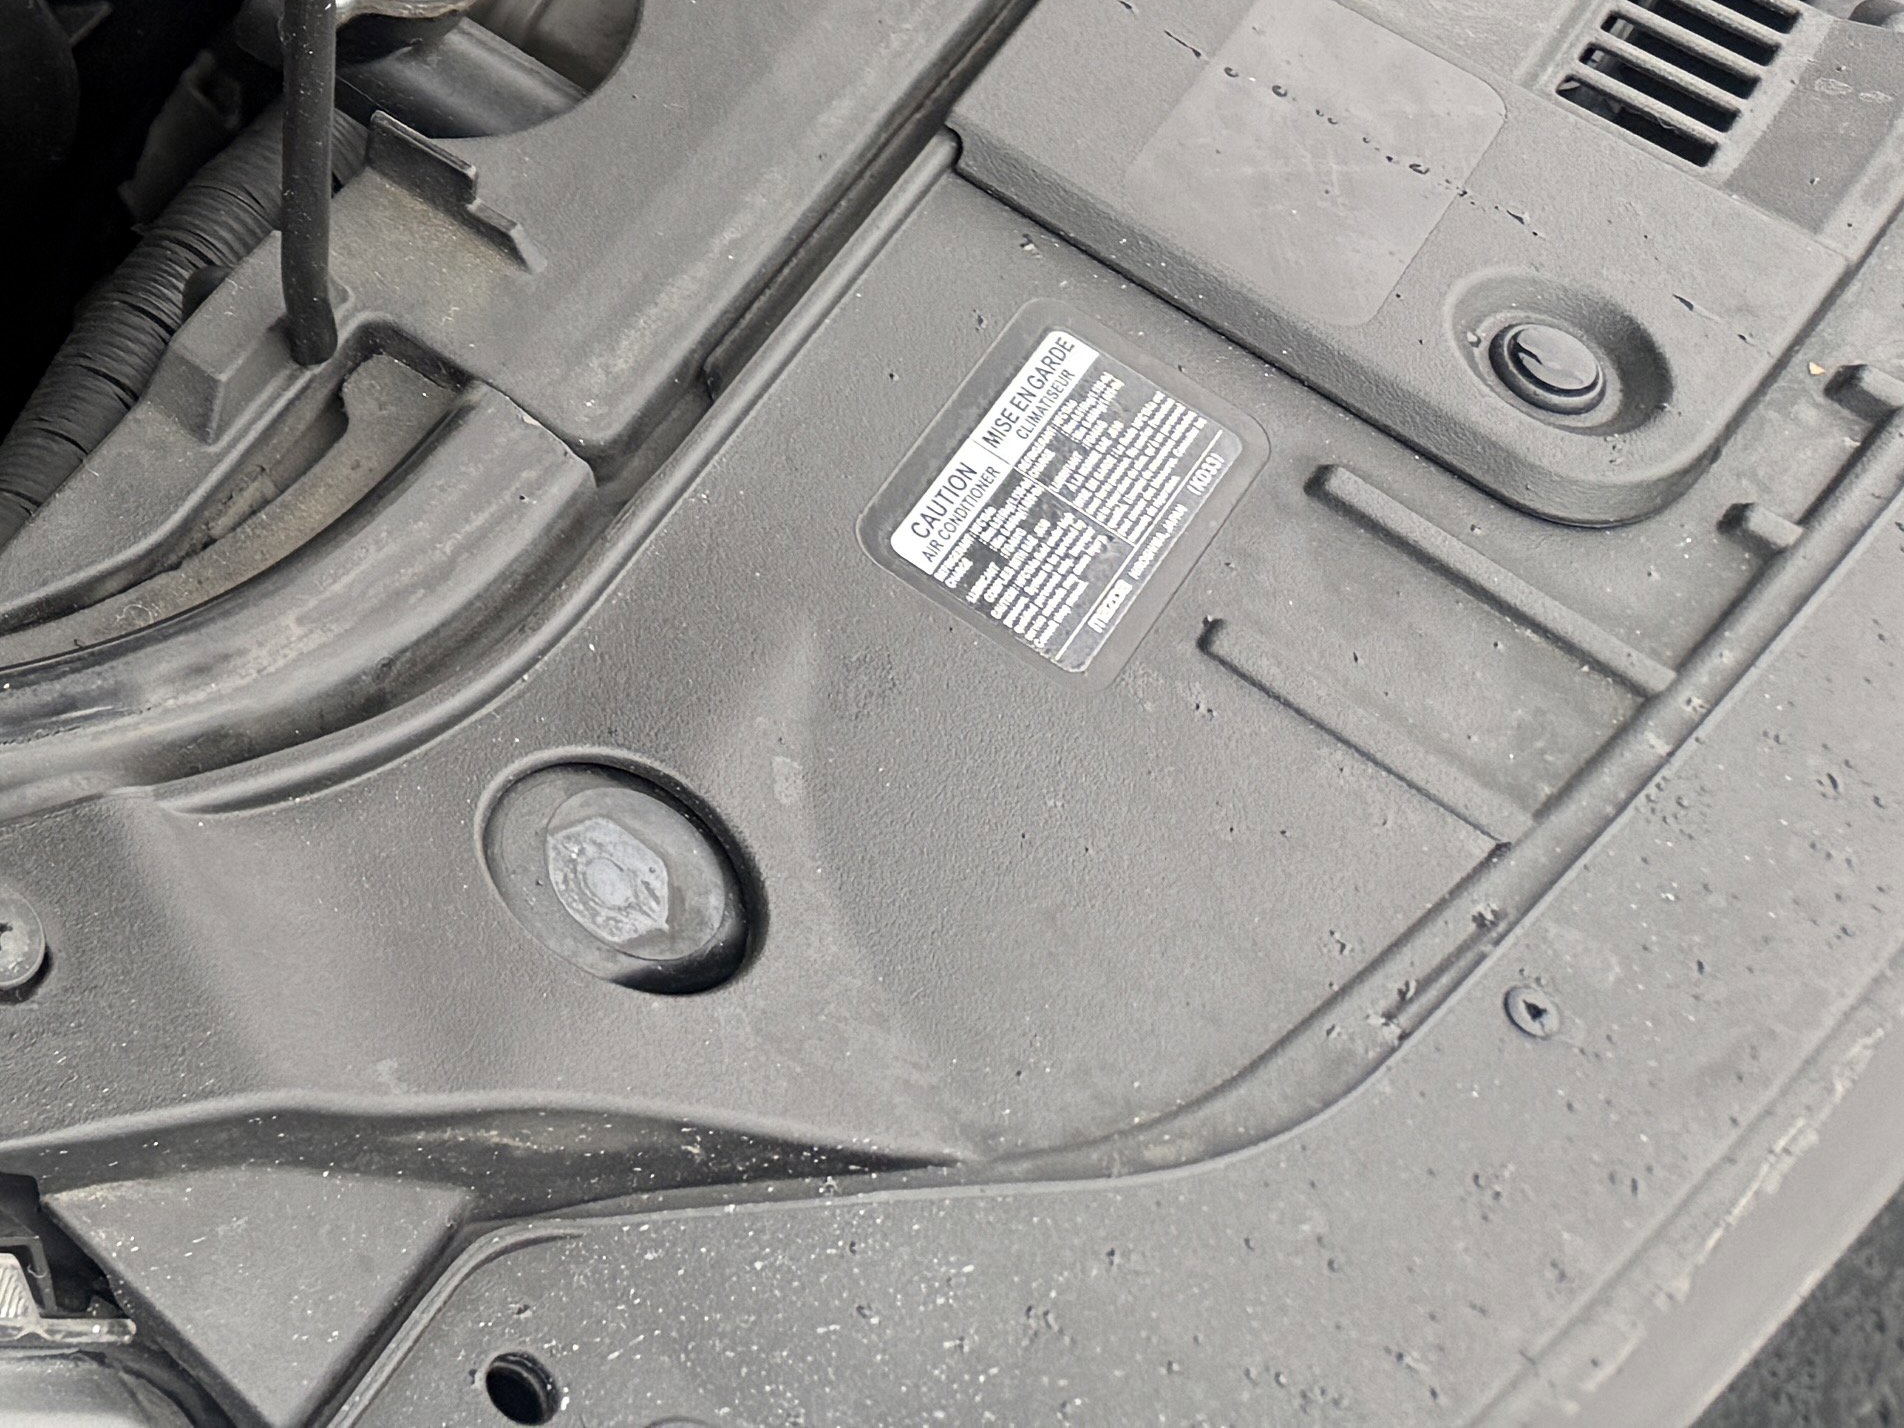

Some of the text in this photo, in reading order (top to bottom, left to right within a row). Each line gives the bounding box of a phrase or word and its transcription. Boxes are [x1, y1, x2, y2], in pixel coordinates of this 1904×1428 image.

[982, 408, 1020, 448] MISE
[1010, 386, 1036, 412] EN
[1027, 337, 1075, 389] GARDE
[1016, 369, 1075, 440] CLIMATISEUR
[911, 462, 977, 538] CAUTION
[922, 466, 1000, 562] AIR CONDITIONER
